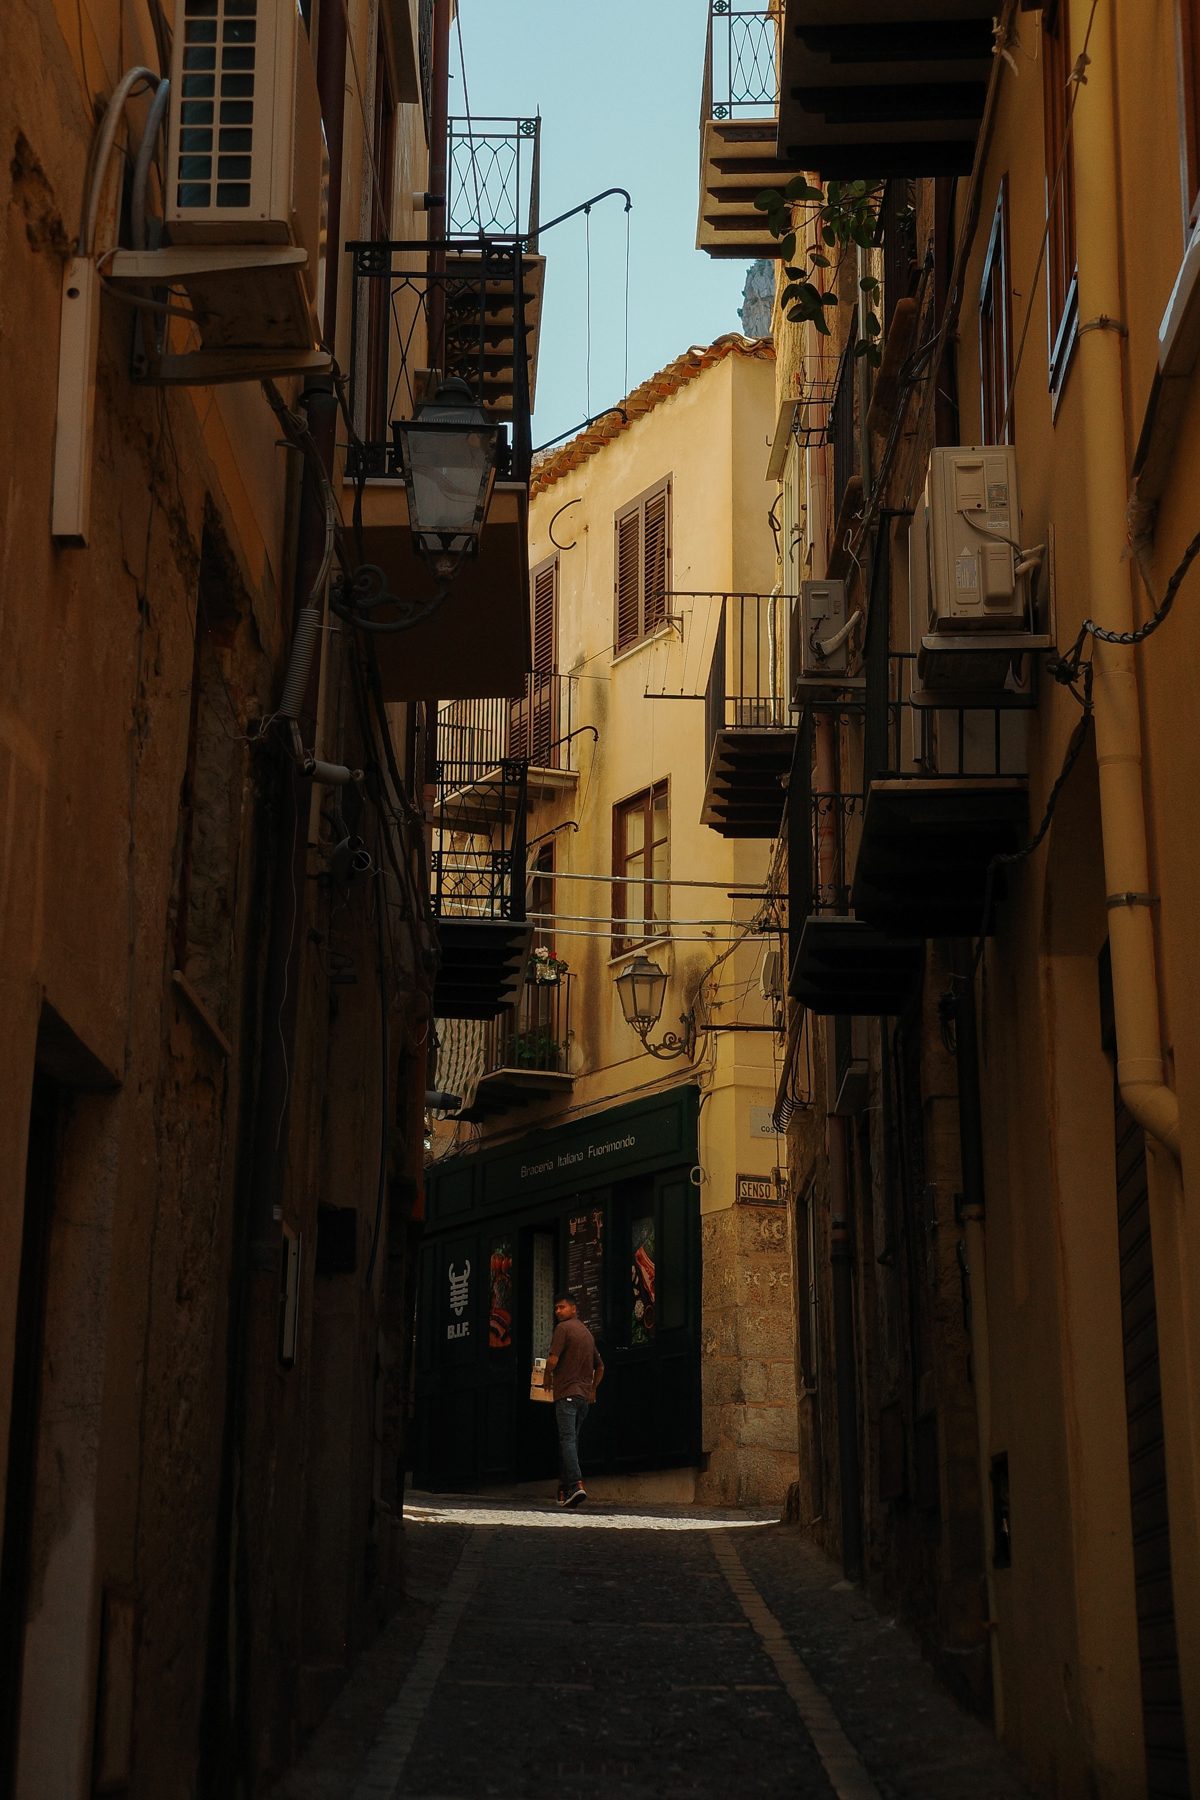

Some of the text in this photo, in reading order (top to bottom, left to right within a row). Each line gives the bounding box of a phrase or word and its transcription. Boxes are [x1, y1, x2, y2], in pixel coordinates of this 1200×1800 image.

[760, 1125, 776, 1134] COS
[520, 1134, 636, 1178] Braceria Italiana Fuorimondo
[741, 1182, 771, 1199] SENSO
